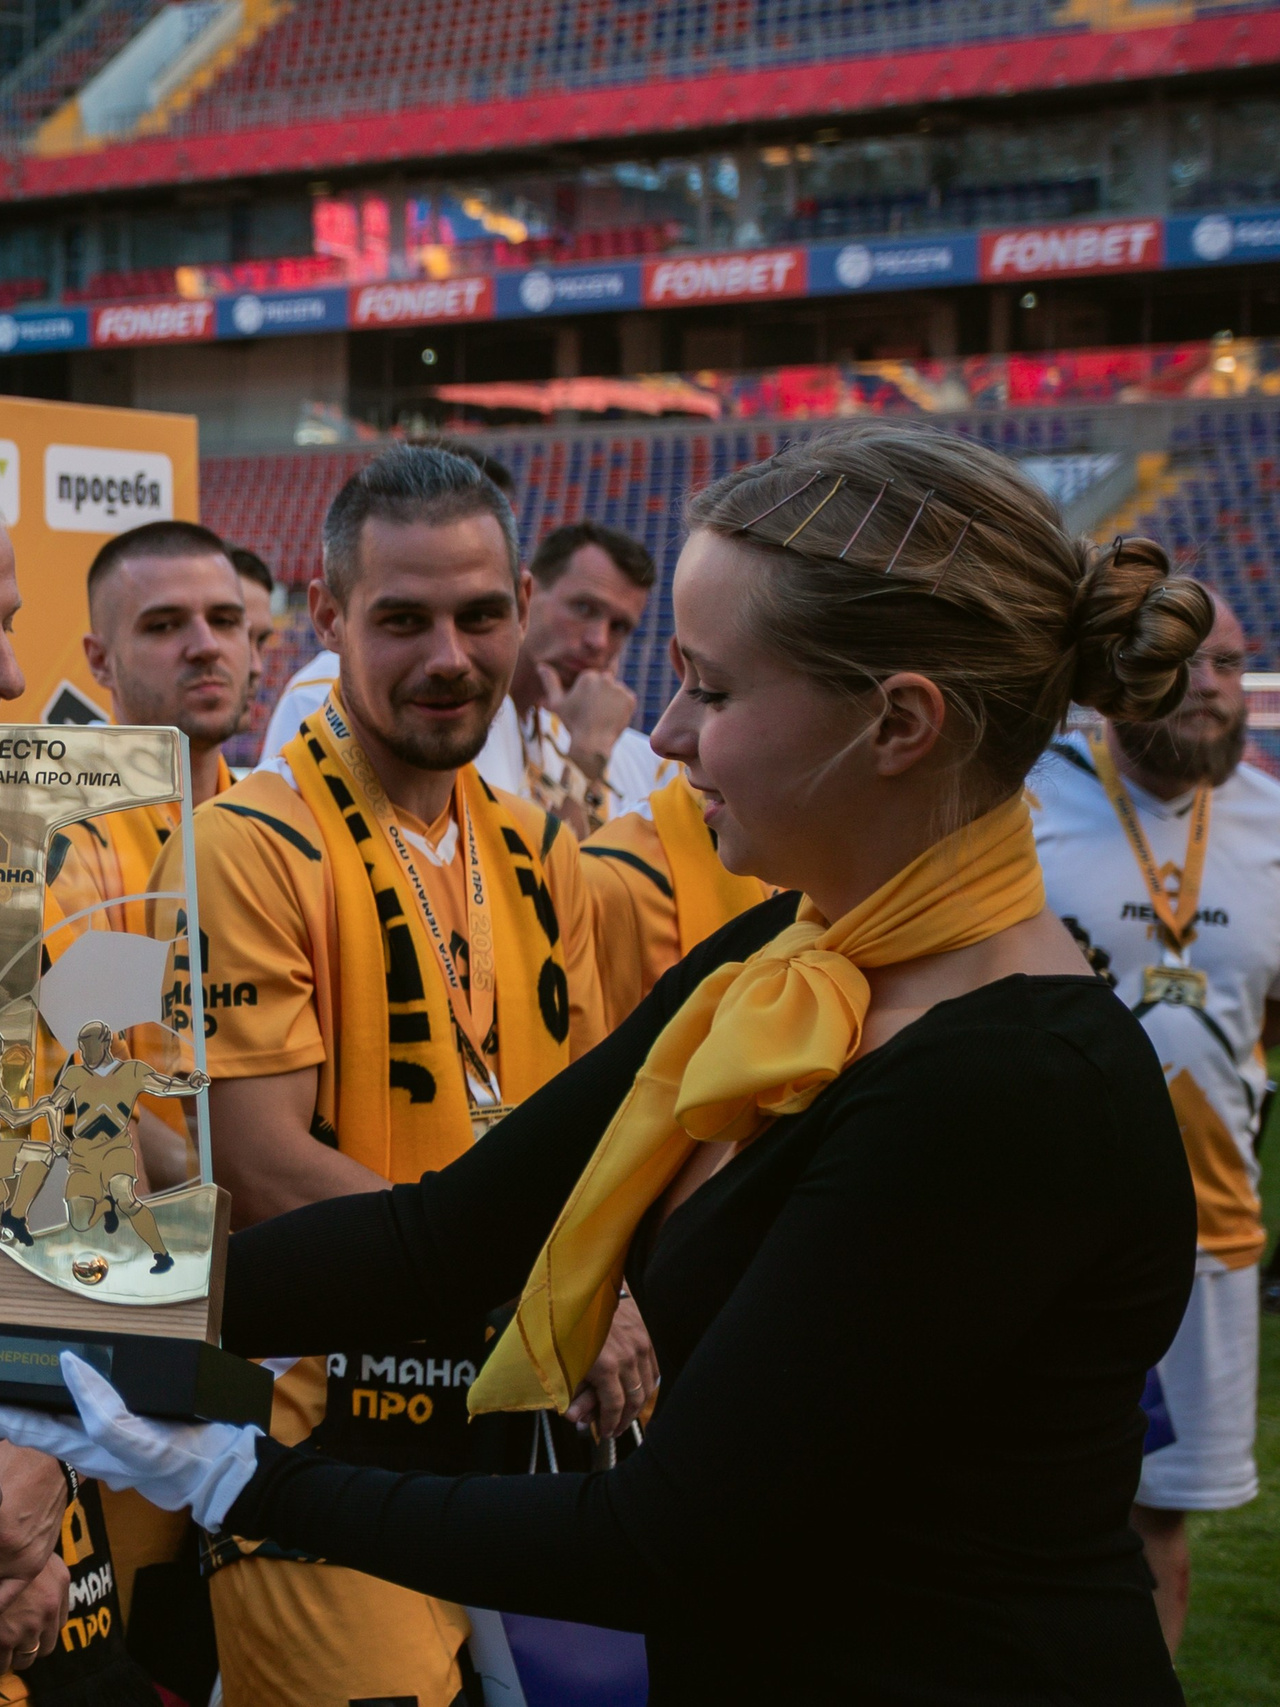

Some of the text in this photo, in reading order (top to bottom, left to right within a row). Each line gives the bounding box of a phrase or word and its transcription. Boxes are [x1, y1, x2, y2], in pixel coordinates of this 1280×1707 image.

[991, 221, 1157, 275] FONBET
[651, 253, 797, 299] FONBET
[96, 301, 214, 344] FONBET
[356, 278, 487, 323] FONBET
[58, 471, 161, 515] просебя
[325, 705, 351, 739] ЛИГА
[35, 771, 71, 786] ПРО
[76, 772, 121, 787] ЛИГА
[389, 826, 409, 860] ПРО
[407, 864, 441, 939] ЛЕМАНА
[472, 870, 484, 905] ПРО
[438, 942, 459, 988] ЛИГА
[470, 913, 494, 993] 2025
[352, 1388, 434, 1425] ПРО
[61, 1607, 111, 1652] ПРО
